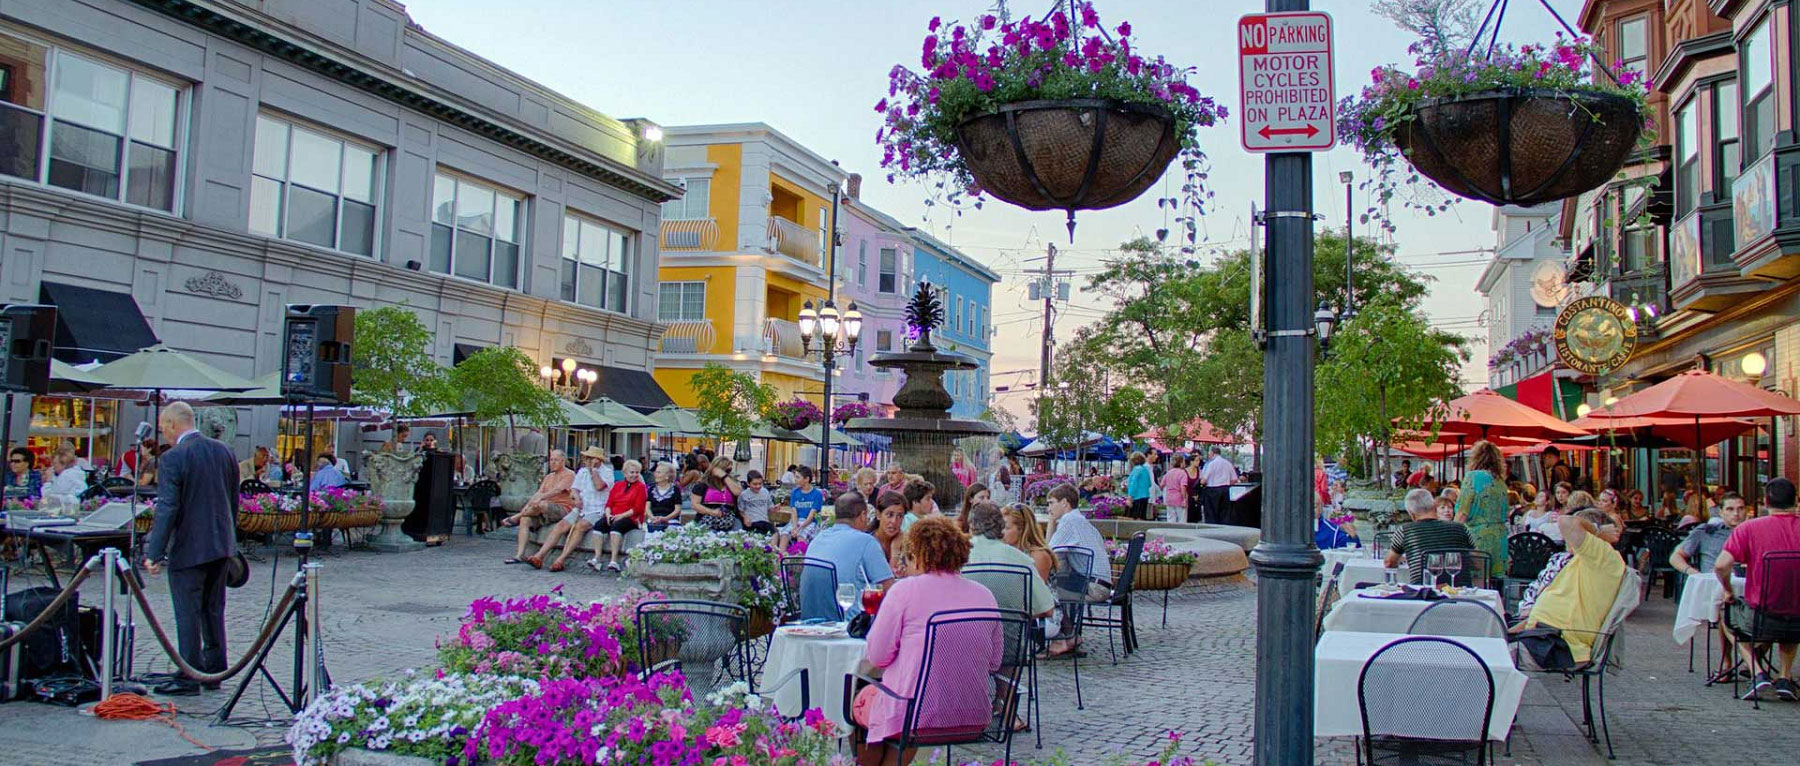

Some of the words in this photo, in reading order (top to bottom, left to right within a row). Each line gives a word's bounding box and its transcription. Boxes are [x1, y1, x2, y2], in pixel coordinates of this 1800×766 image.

[1241, 23, 1265, 48] NO
[1269, 25, 1325, 44] PARKING
[1253, 55, 1318, 71] MOTOR
[1254, 72, 1319, 87] CYCLES
[1245, 88, 1328, 105] PROHIBITED
[1247, 108, 1268, 123] ON
[1277, 105, 1329, 122] PLAZA
